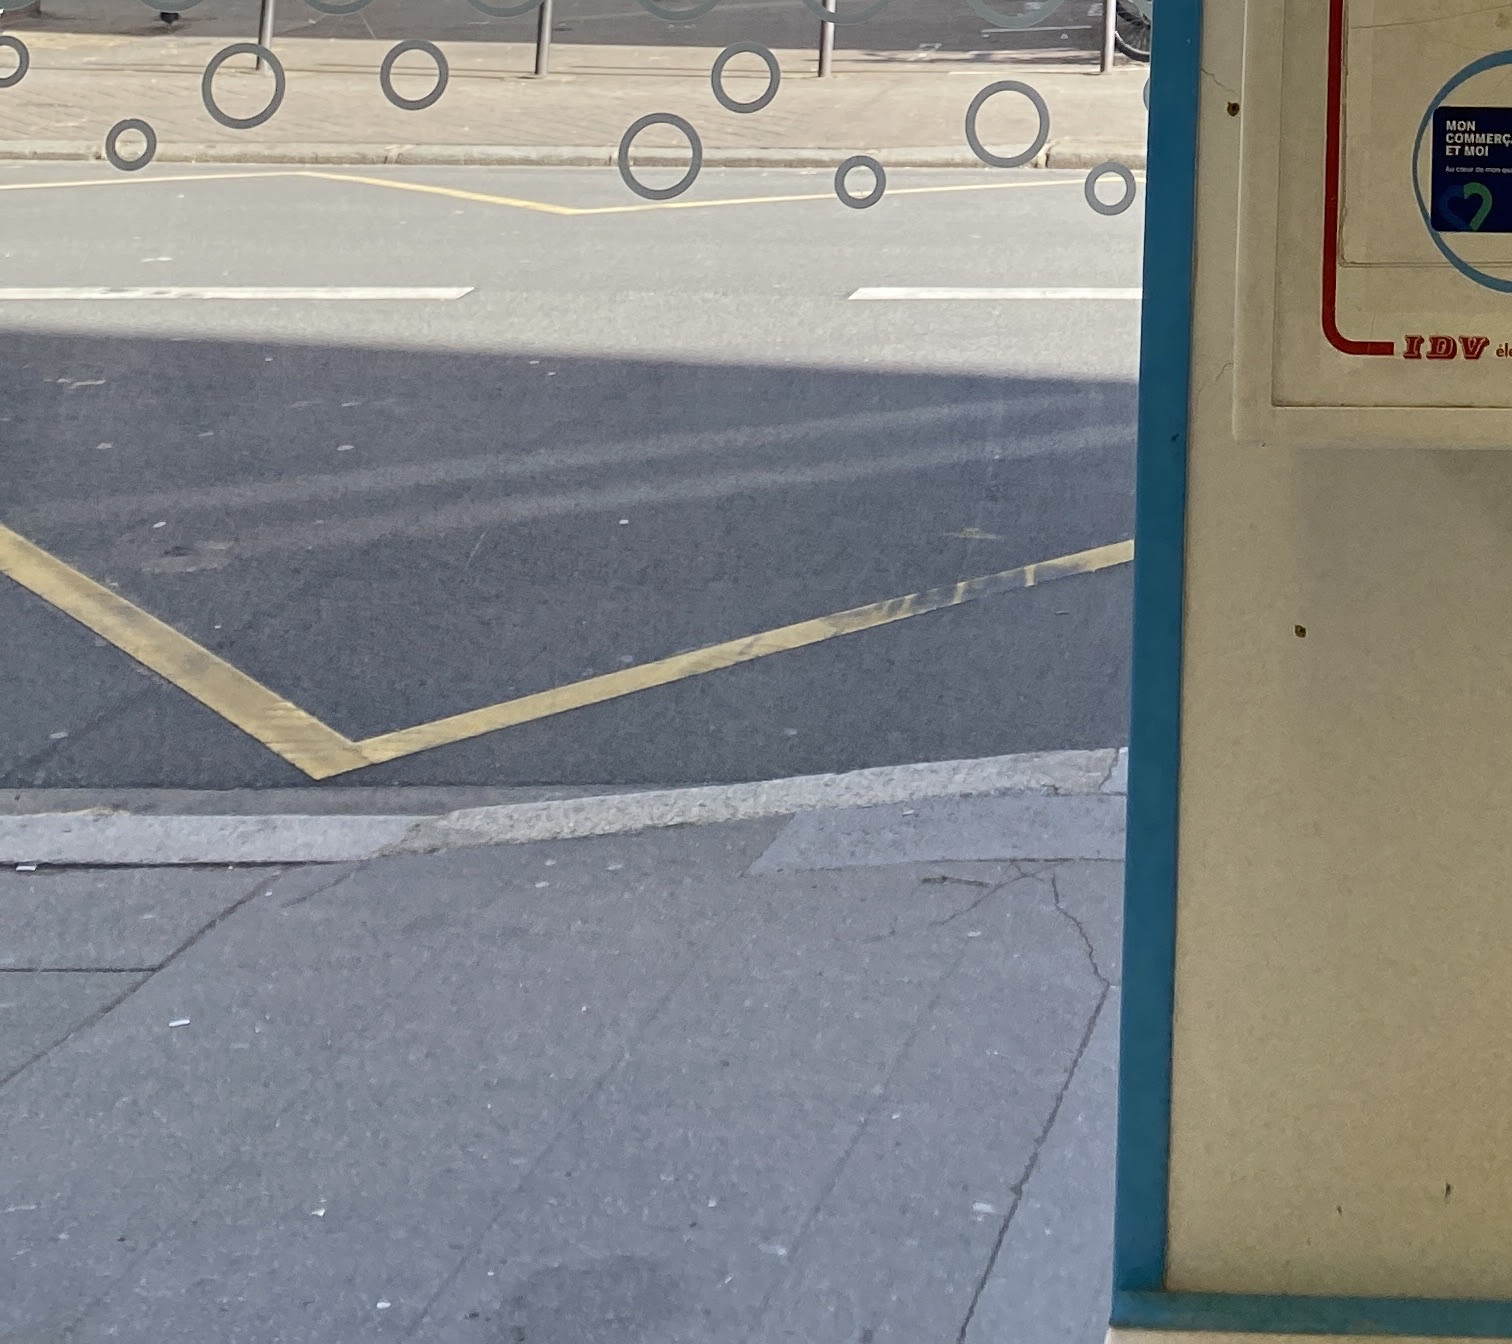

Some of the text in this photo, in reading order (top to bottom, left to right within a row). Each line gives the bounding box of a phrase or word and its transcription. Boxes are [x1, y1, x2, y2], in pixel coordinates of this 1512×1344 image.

[1446, 120, 1476, 132] MON
[1445, 145, 1489, 157] ET MOI
[1403, 334, 1490, 360] IDV
